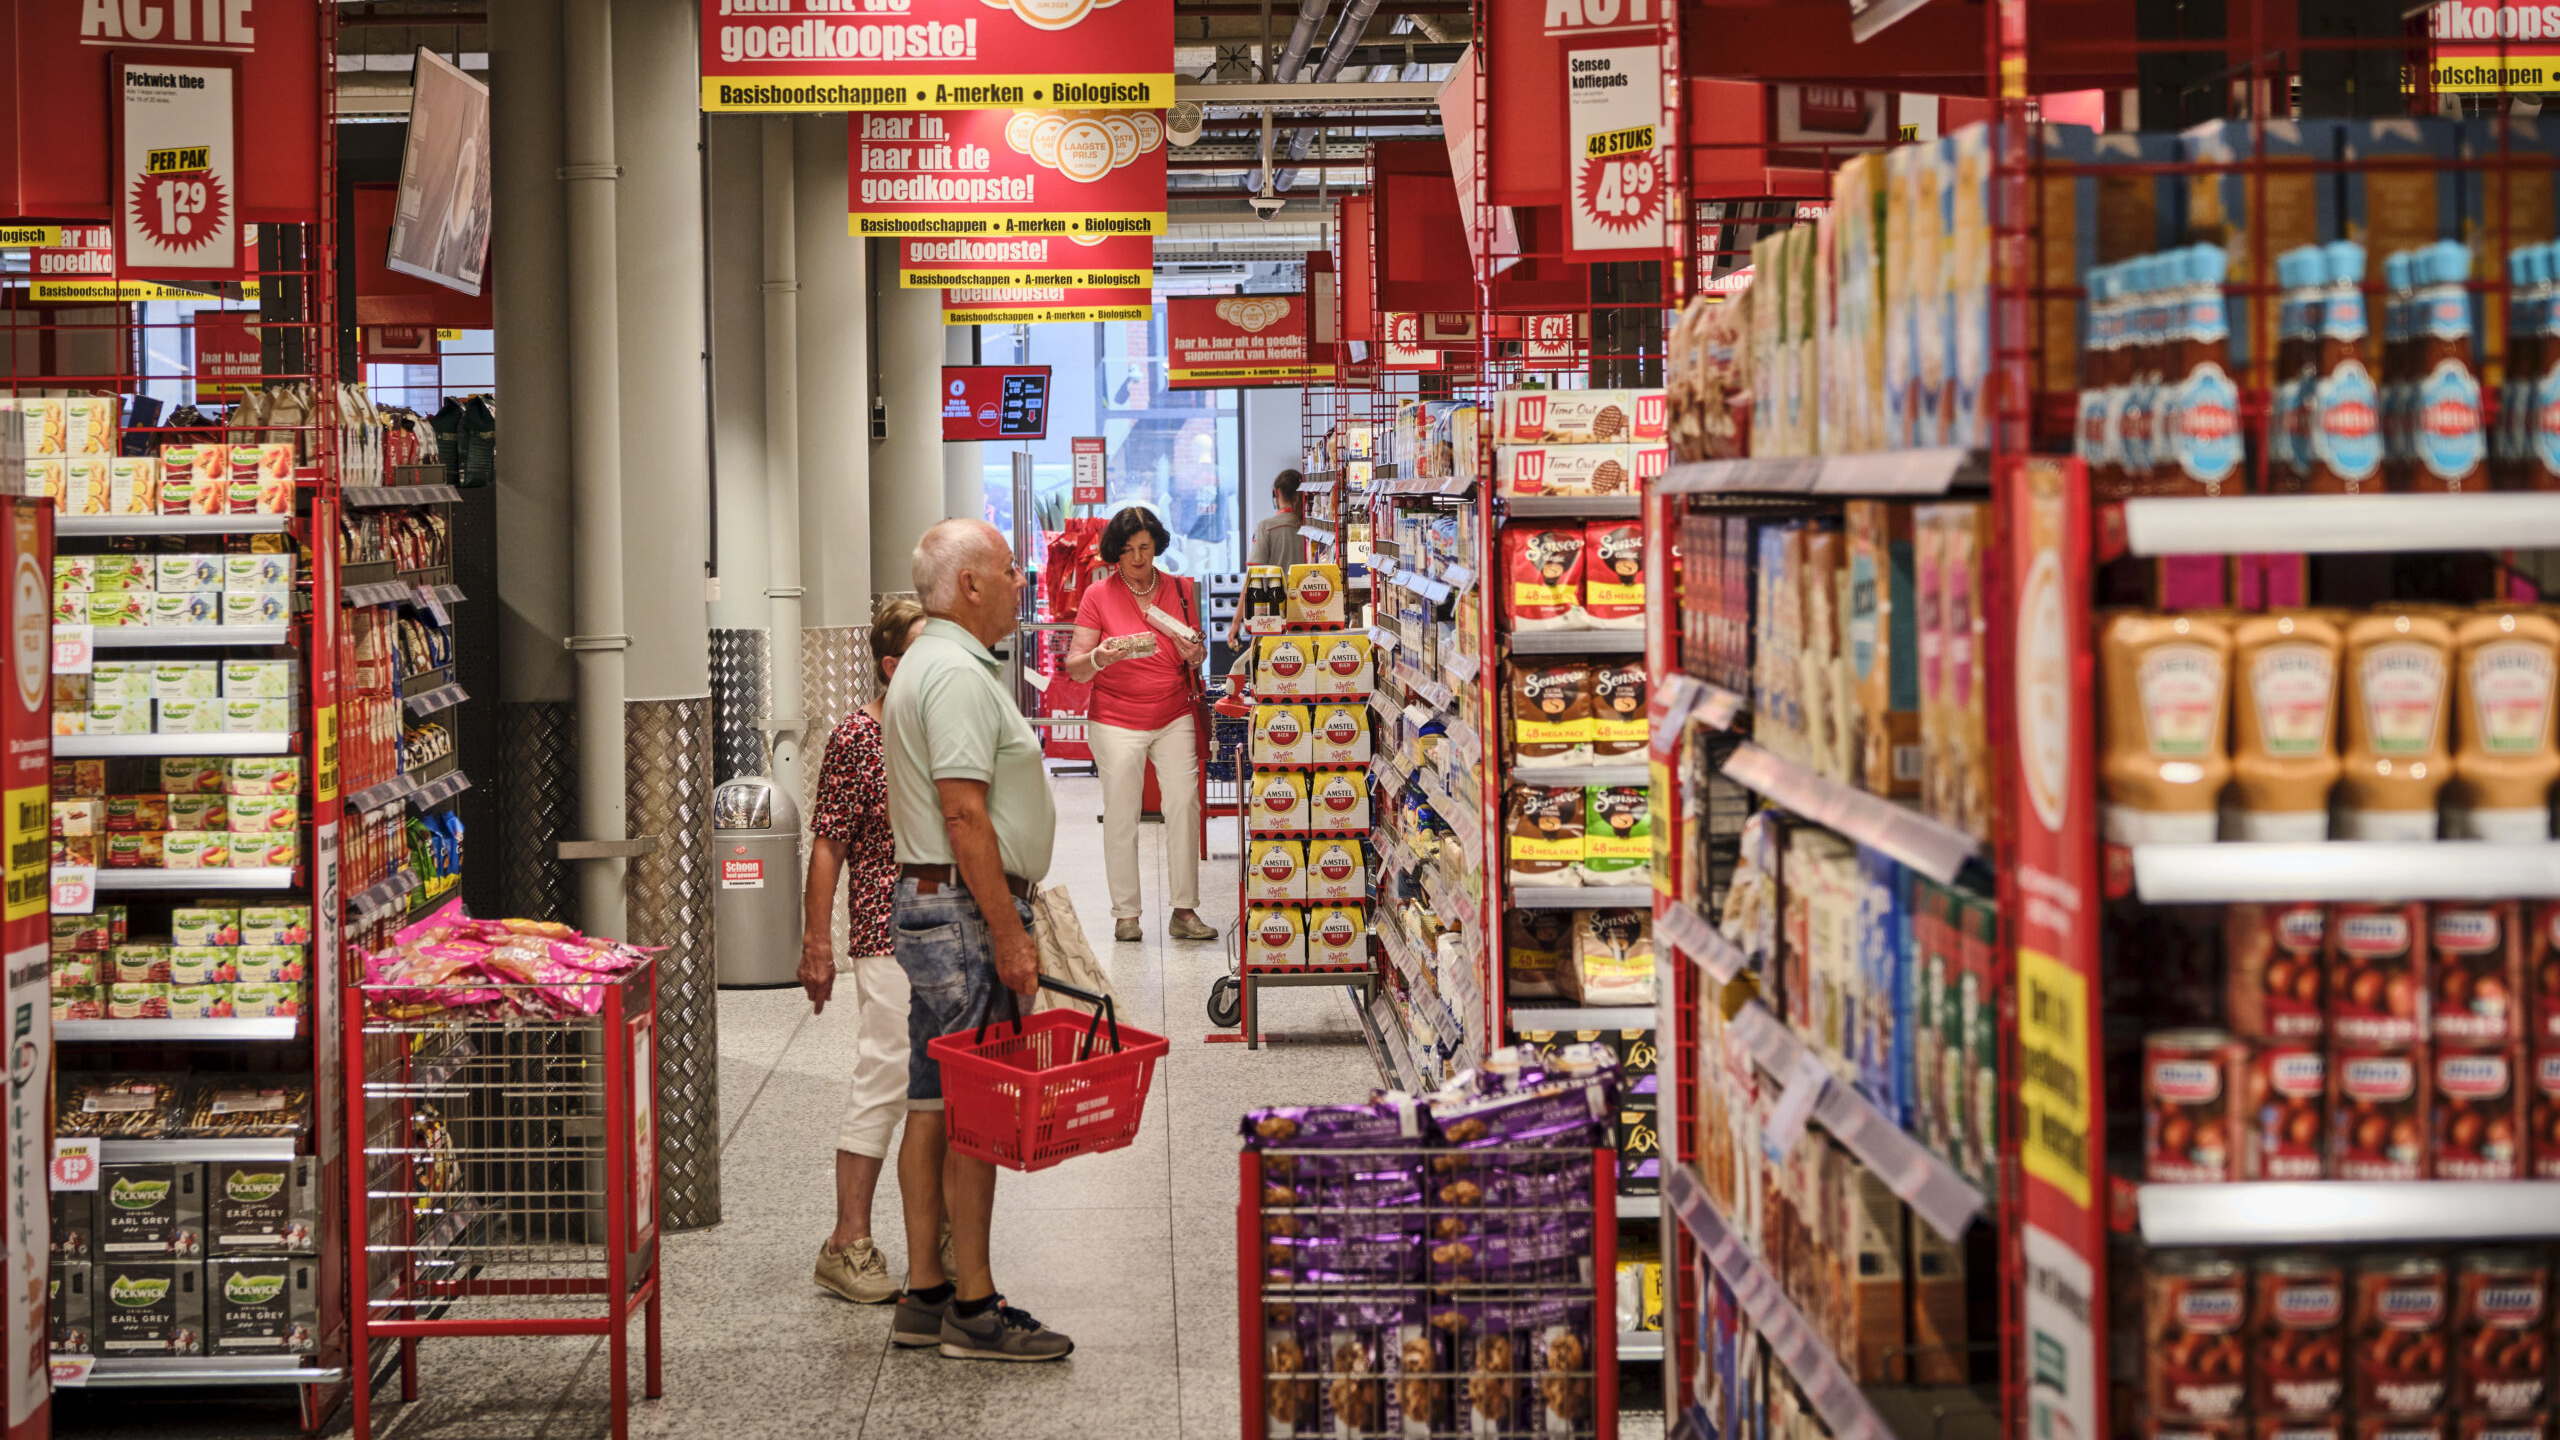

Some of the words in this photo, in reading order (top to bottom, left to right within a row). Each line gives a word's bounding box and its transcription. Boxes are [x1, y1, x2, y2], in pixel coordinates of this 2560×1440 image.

[720, 18, 977, 62] goedkoopste!
[1572, 59, 1610, 72] Senseo
[126, 72, 176, 88] Pickwick
[179, 74, 205, 89] thee
[1572, 73, 1628, 89] koffiepads
[720, 84, 907, 106] Basisboodschappen
[936, 83, 1024, 103] A-merken
[1053, 82, 1150, 104] Biologisch
[861, 114, 914, 141] Jaar
[919, 113, 950, 142] in,
[1065, 142, 1106, 150] LAAGSTE
[1589, 136, 1606, 154] 48
[1609, 128, 1652, 152] STUKS
[150, 151, 176, 171] PER
[180, 149, 207, 170] PAK
[861, 144, 913, 172] jaar
[918, 144, 952, 170] uit
[957, 143, 990, 170] de
[1073, 151, 1098, 159] PRIJS
[861, 175, 1034, 204] goedkoopste!
[861, 218, 987, 234] Basisboodschappen
[1006, 217, 1066, 233] A-merken
[1085, 217, 1151, 234] Biologisch
[910, 240, 1048, 263] goedkoopste!
[910, 274, 1010, 286] Basisboodschappen
[1025, 274, 1073, 285] A-merken
[1087, 273, 1141, 286] Biologisch
[39, 285, 141, 299] Basisboodschappen
[950, 311, 1034, 324] Basisboodschappen
[1045, 310, 1086, 321] A-merken
[1098, 309, 1142, 321] Biologisch
[1175, 337, 1195, 350] Jaar
[1212, 337, 1232, 350] jaar
[1235, 336, 1249, 347] uit
[1251, 335, 1264, 347] de
[1185, 351, 1245, 362] supermarkt
[1247, 351, 1265, 360] van
[1519, 401, 1541, 426] LU
[1547, 402, 1574, 415] Time
[1577, 403, 1598, 415] Out
[1639, 400, 1662, 426] LU
[1518, 455, 1541, 481] LU
[1546, 457, 1573, 470] Time
[1575, 457, 1597, 469] Out
[1598, 591, 1612, 600] 48
[1524, 670, 1587, 697] Senseo
[1526, 729, 1539, 739] 48
[1597, 727, 1611, 737] 48
[1521, 845, 1534, 855] 48
[1593, 843, 1606, 853] 48
[725, 861, 759, 872] Schoon
[1590, 912, 1644, 935] Senseo
[227, 1181, 281, 1195] PICKWICK
[111, 1190, 166, 1203] PICKWICK
[226, 1210, 253, 1218] EARL
[257, 1209, 284, 1218] GREY
[111, 1218, 138, 1226] EARL
[142, 1216, 170, 1225] GREY
[111, 1287, 166, 1299] PICKWICK
[226, 1283, 280, 1296] PICKWICK
[112, 1315, 138, 1323] EARL
[142, 1315, 170, 1323] GREY
[226, 1312, 253, 1321] EARL
[256, 1312, 284, 1320] GREY
